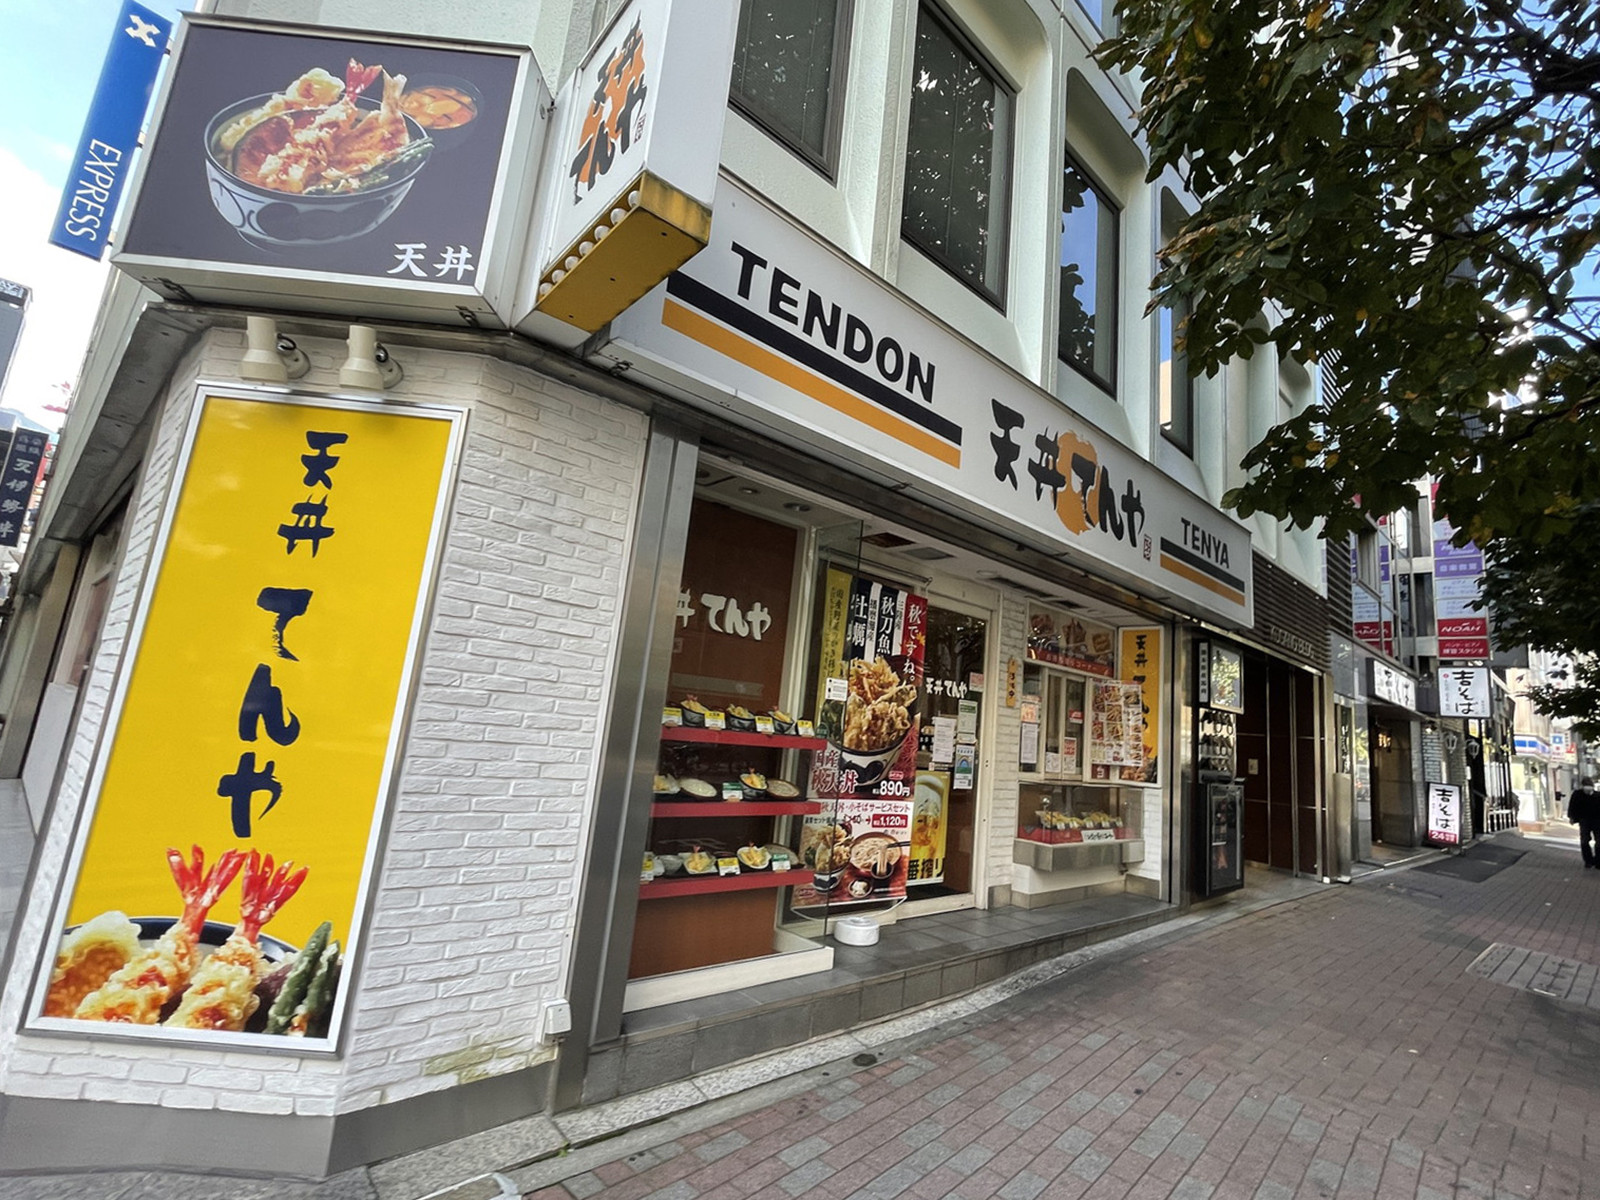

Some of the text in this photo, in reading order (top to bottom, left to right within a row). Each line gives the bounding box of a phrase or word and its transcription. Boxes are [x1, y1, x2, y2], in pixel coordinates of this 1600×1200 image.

[65, 139, 122, 241] EXPRESS
[386, 242, 475, 281] 天丼
[731, 241, 936, 404] TENDON
[990, 398, 1146, 548] 天丼てんや
[1181, 517, 1230, 569] TENYA
[877, 596, 895, 654] 秋刀魚
[925, 677, 967, 699] 天丼てんや
[1452, 670, 1479, 715] 吉そば
[880, 780, 911, 797] 890円
[1435, 788, 1455, 829] 吉そば
